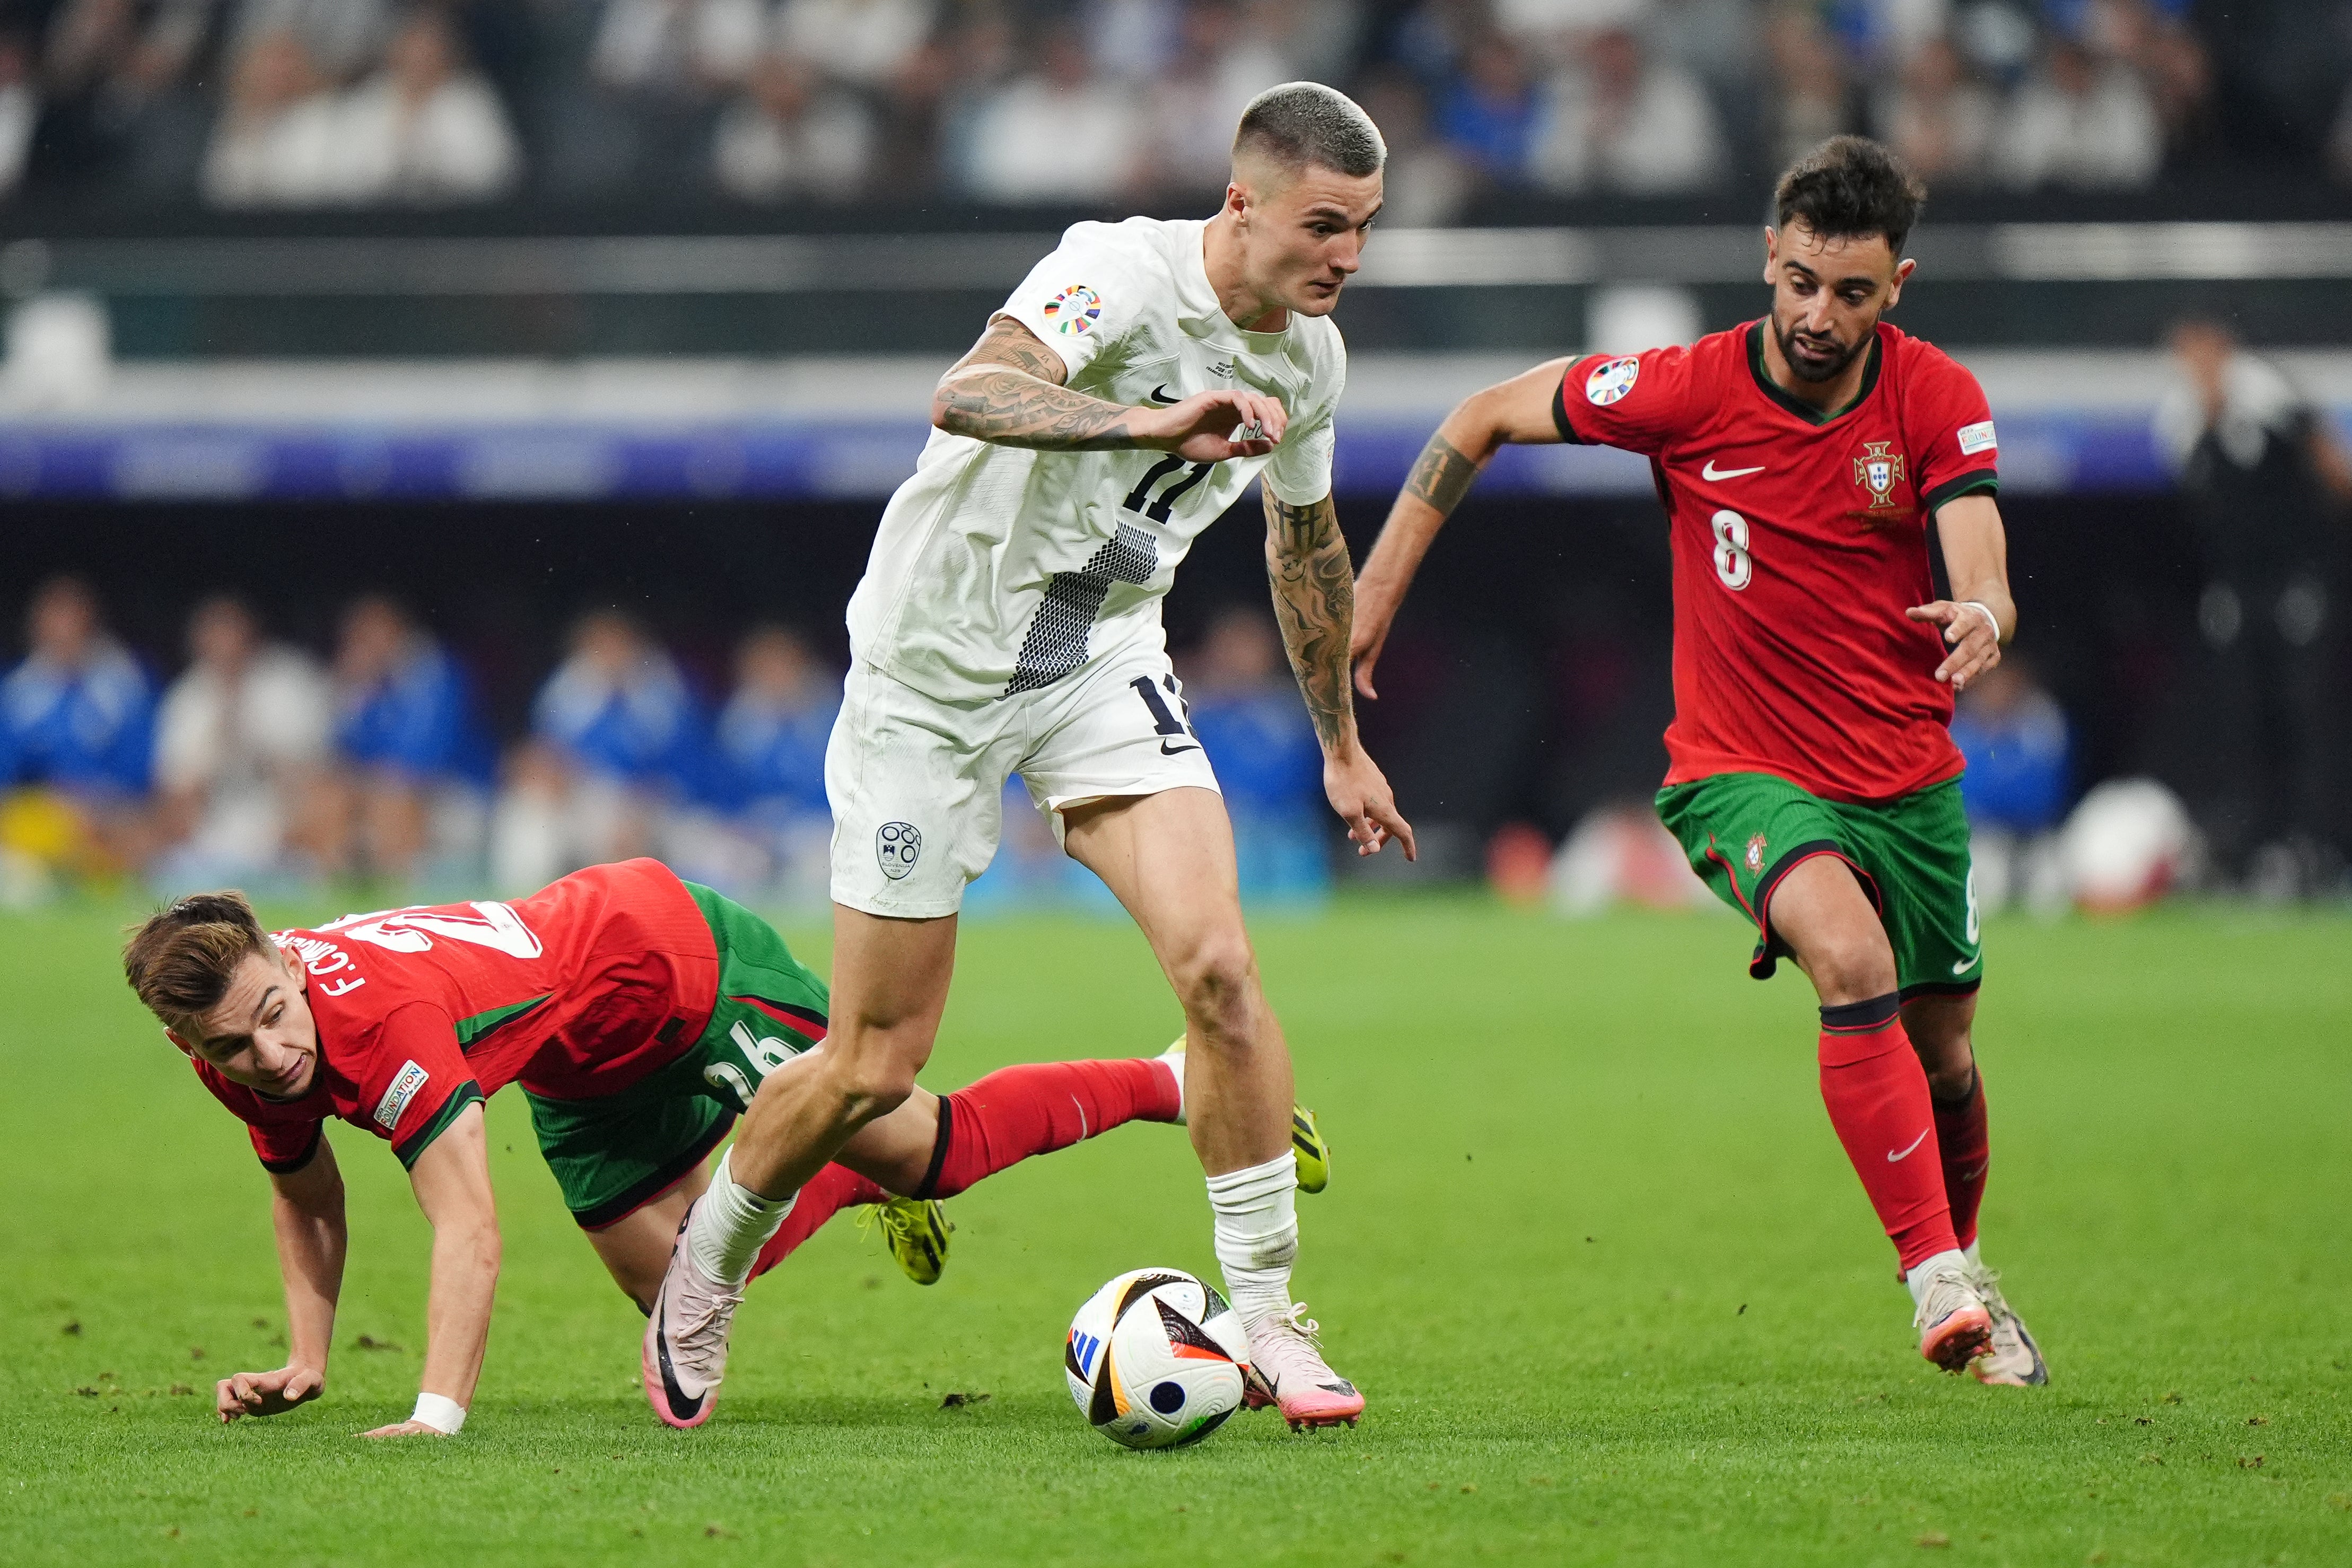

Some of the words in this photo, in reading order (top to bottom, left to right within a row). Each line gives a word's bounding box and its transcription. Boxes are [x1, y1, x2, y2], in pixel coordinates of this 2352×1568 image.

[1123, 453, 1216, 524] 11
[1711, 510, 1752, 591] 8
[380, 1067, 420, 1126] FOUNDATION
